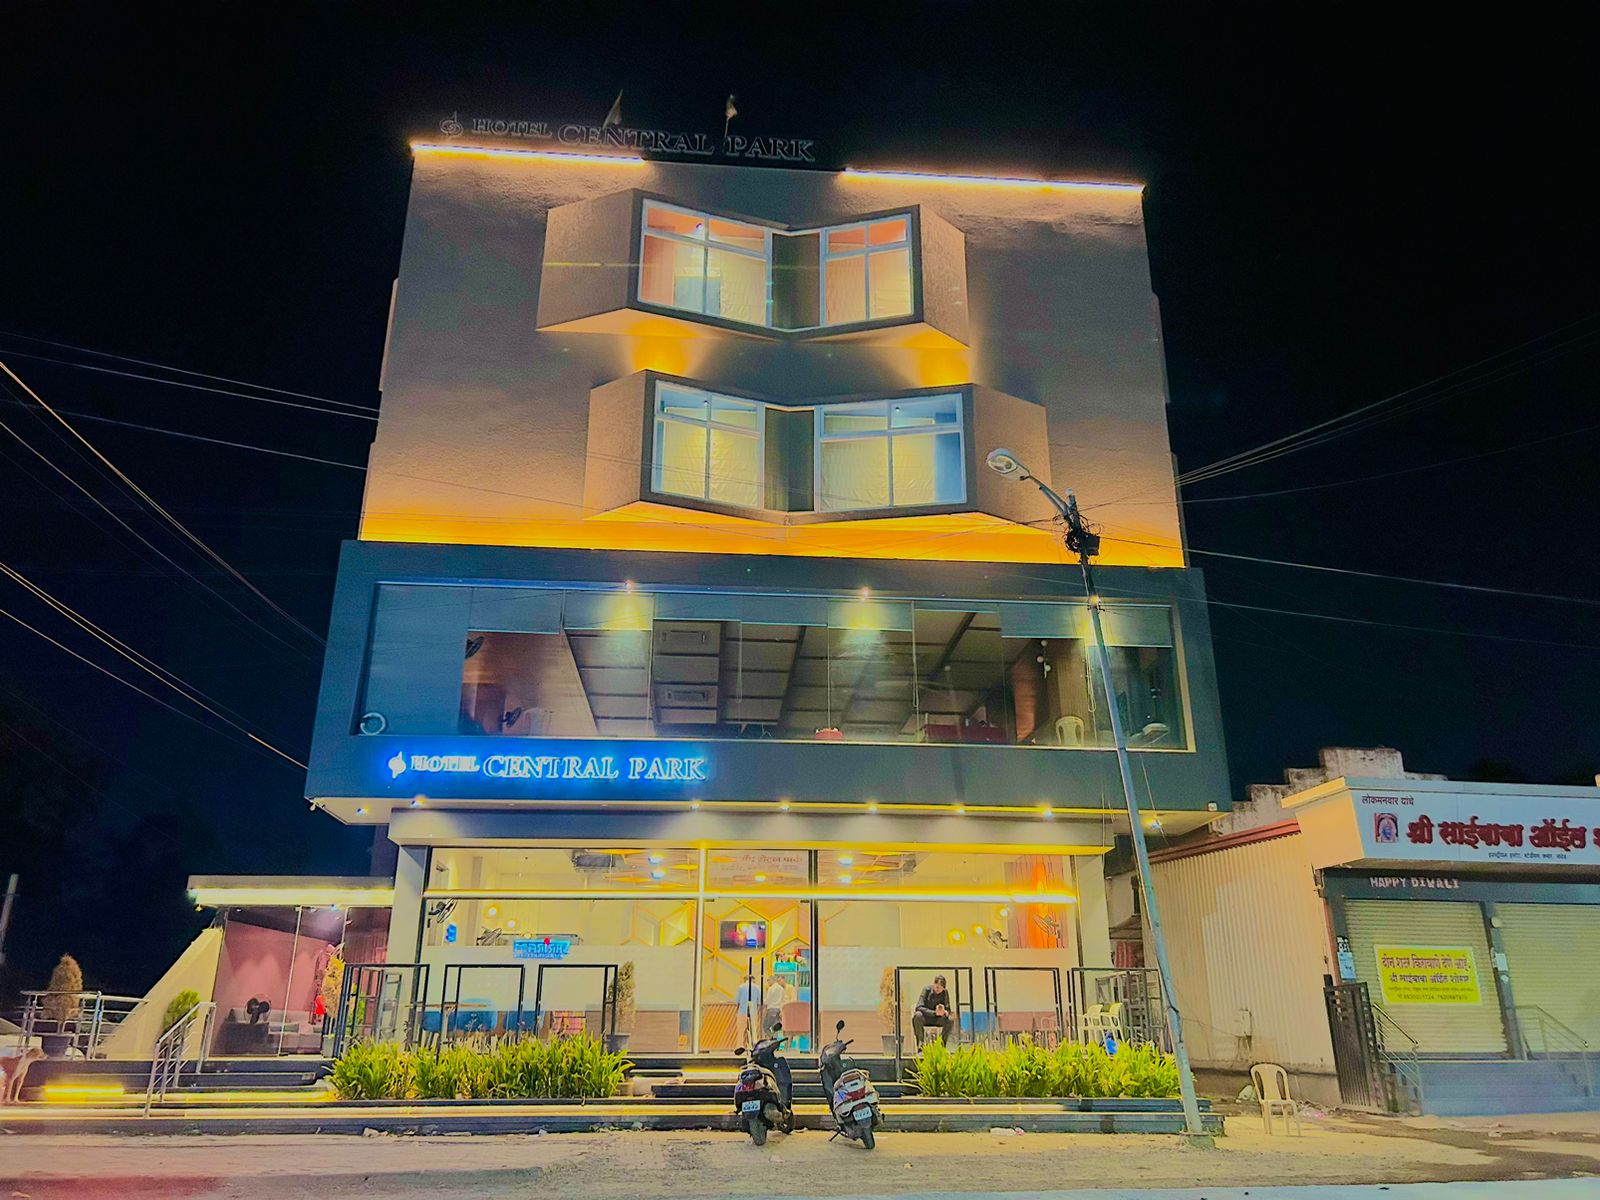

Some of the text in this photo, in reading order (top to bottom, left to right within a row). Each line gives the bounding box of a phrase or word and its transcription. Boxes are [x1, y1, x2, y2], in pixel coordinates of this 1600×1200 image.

[472, 117, 816, 162] HOTEL CENTRAL PARK
[411, 755, 707, 780] HOTEL CENTRAL PARK
[1406, 814, 1434, 845] श्री
[1437, 815, 1524, 849] साईबाबा
[1369, 876, 1460, 889] HAPPY DIWALI
